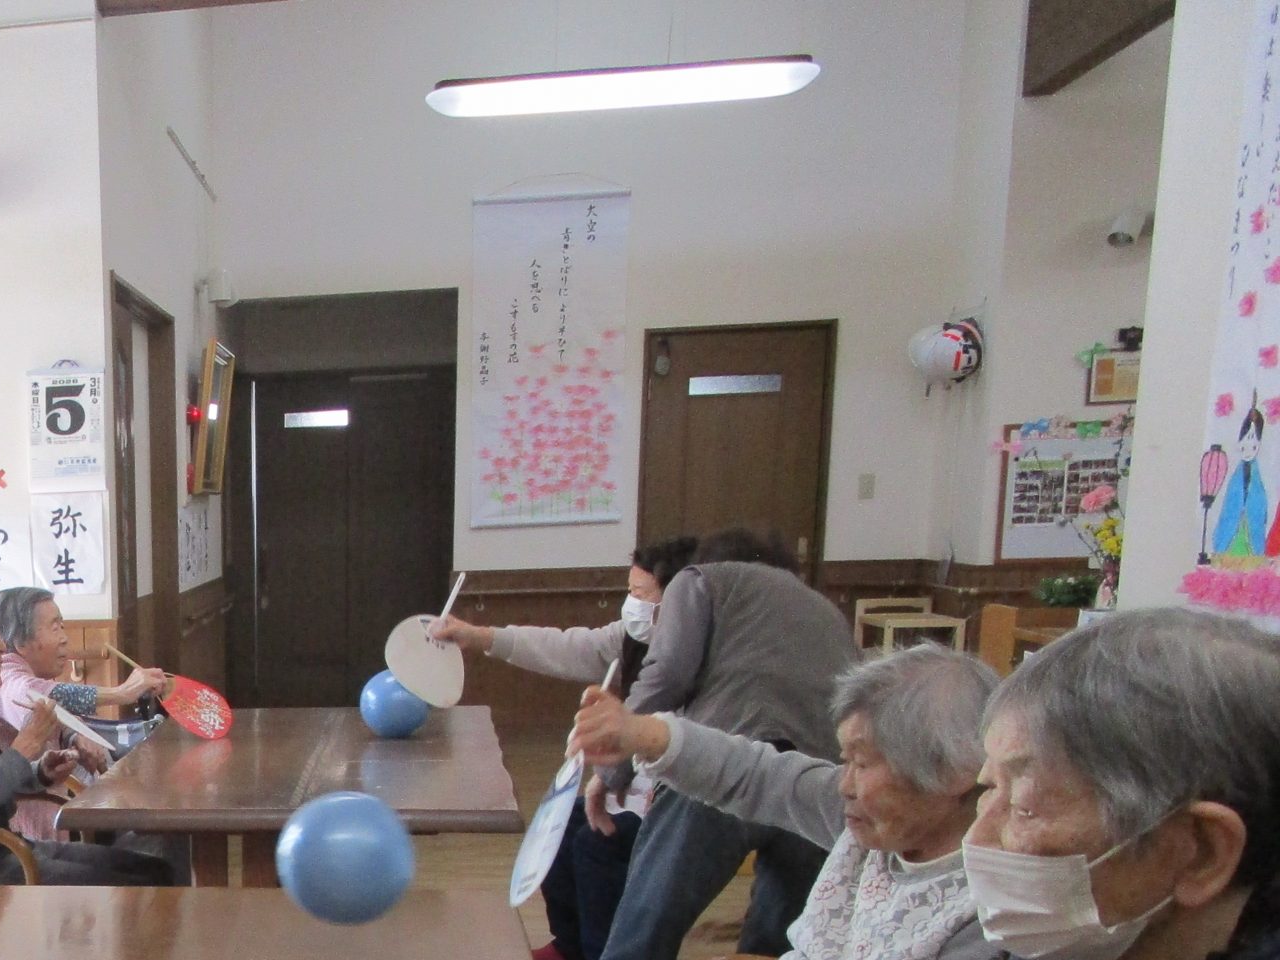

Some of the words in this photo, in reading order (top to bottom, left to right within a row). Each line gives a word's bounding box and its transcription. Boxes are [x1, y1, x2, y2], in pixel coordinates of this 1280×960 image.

[586, 203, 598, 243] 大空の
[45, 383, 86, 436] 5
[89, 377, 97, 397] 3月
[49, 504, 87, 586] 弥生
